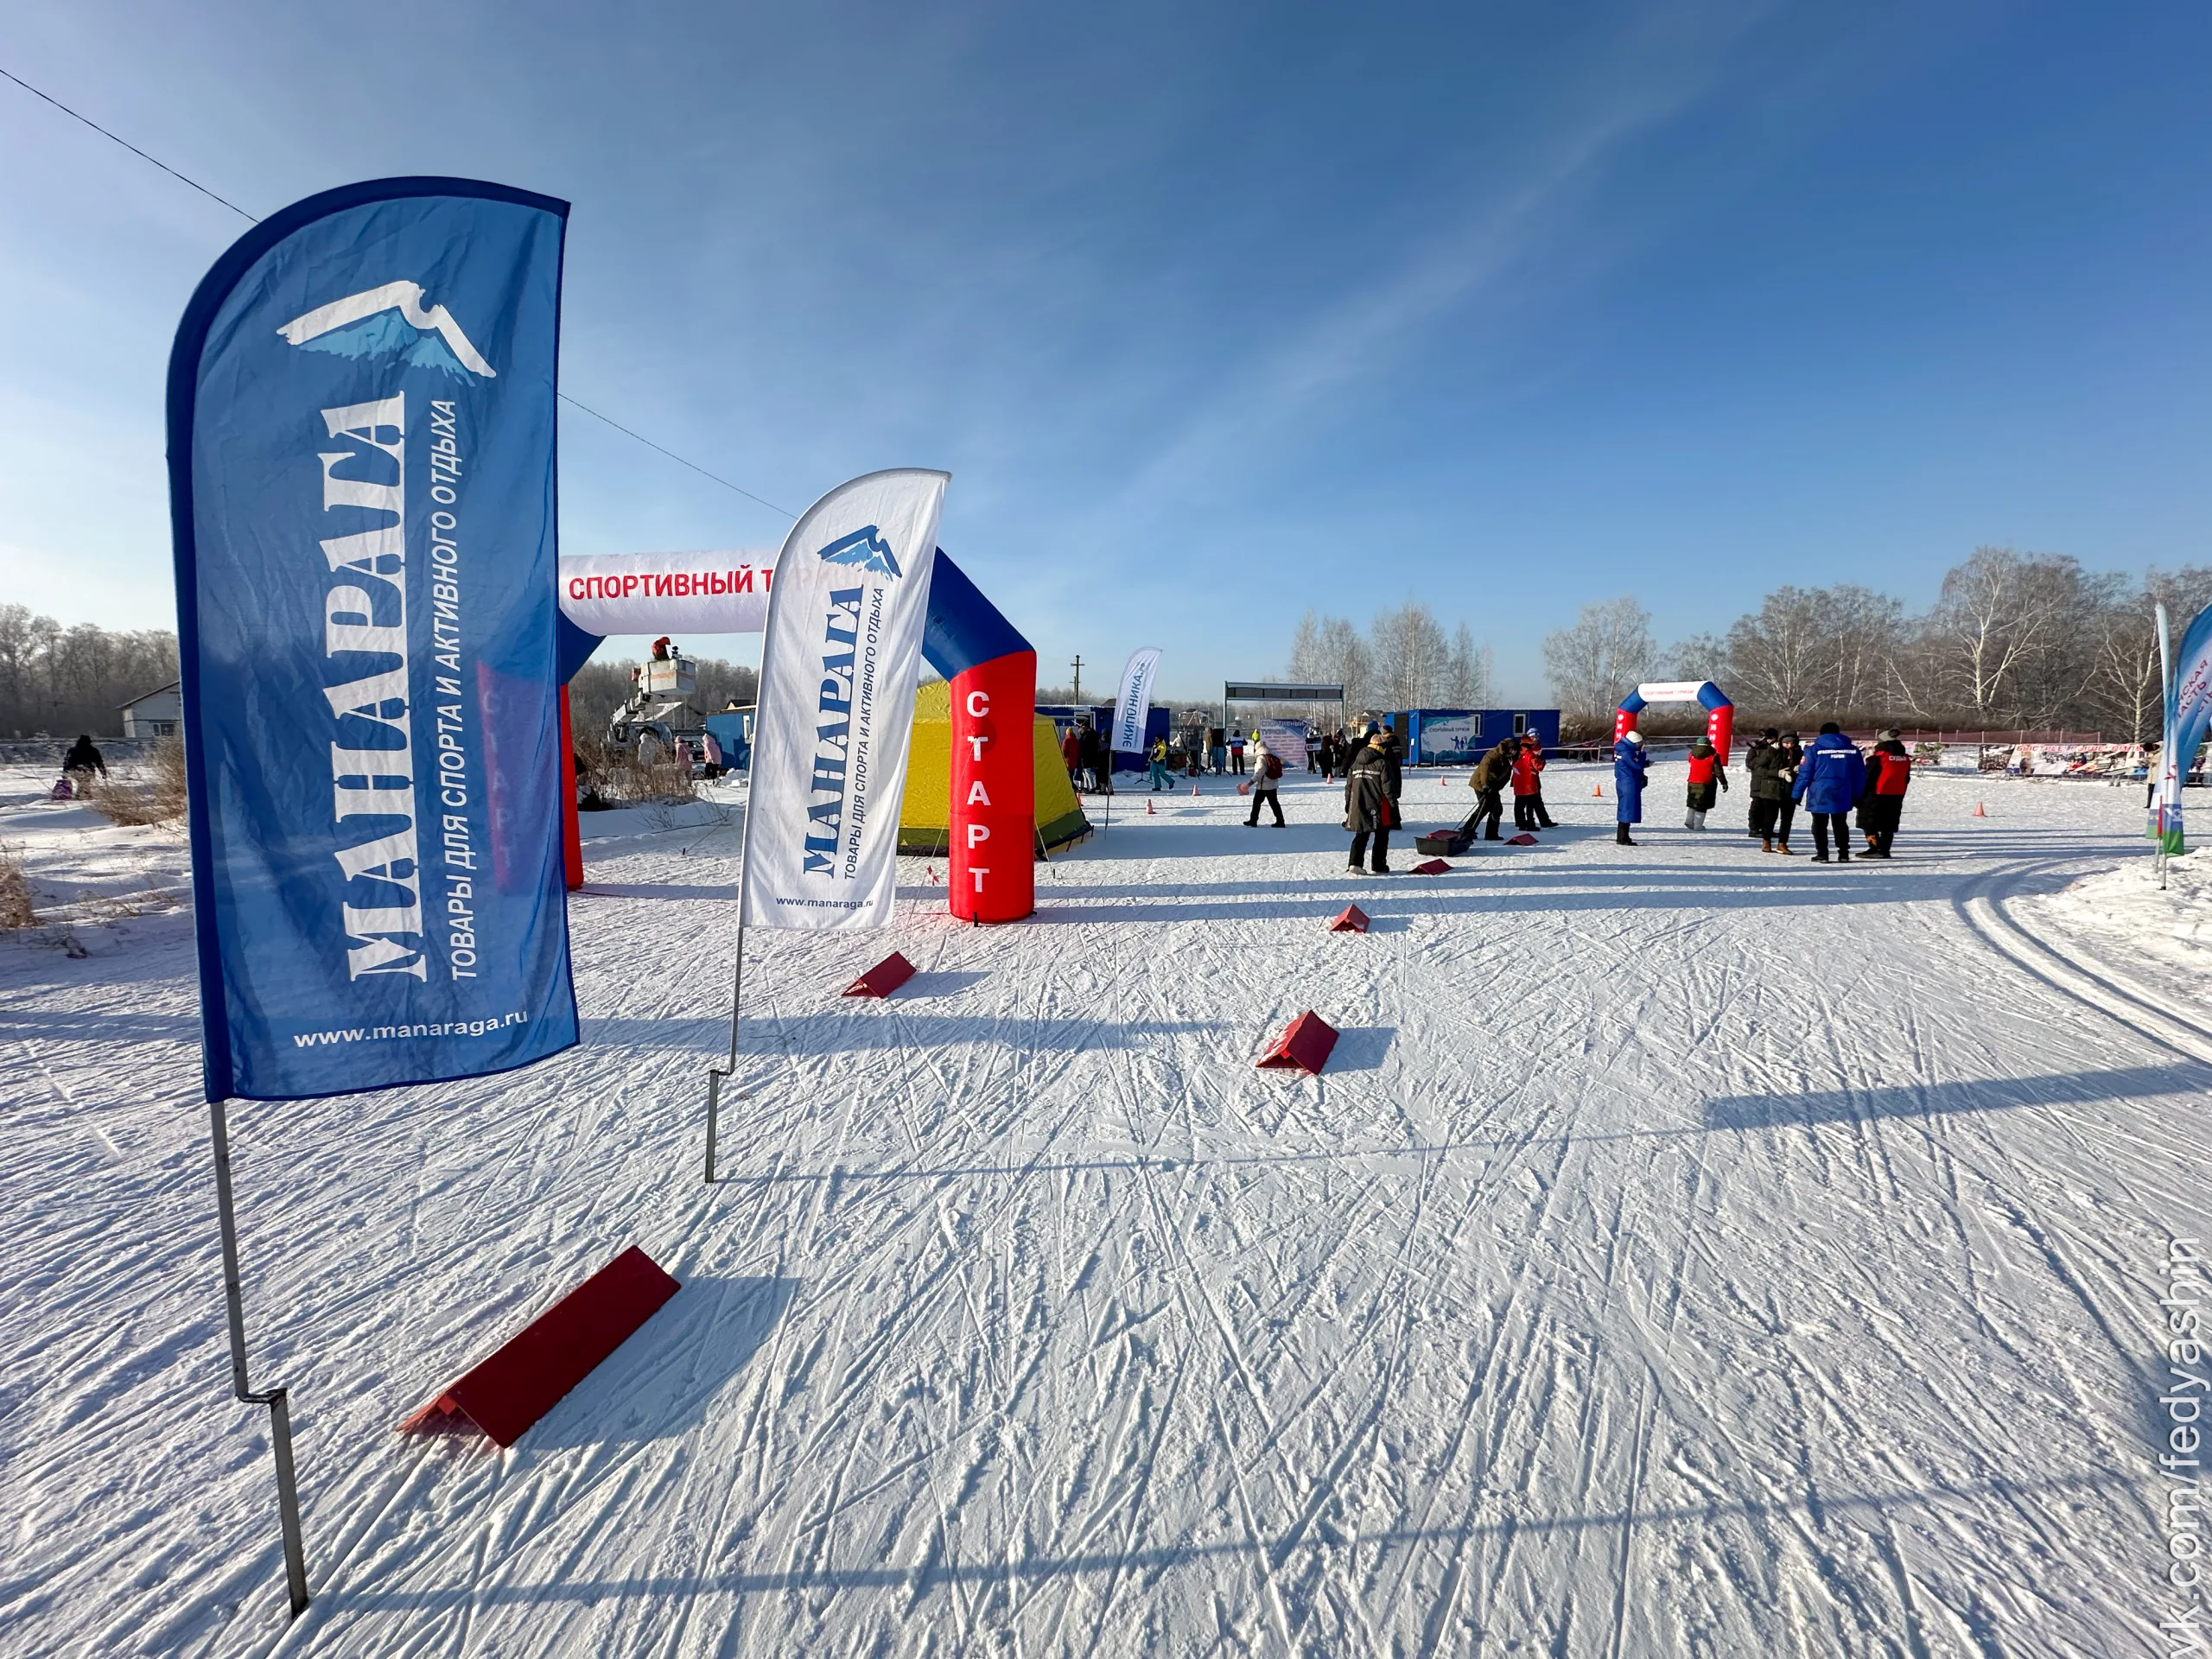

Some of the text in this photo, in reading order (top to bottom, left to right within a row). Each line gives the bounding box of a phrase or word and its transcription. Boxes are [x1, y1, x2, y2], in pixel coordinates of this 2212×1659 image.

[318, 391, 427, 982] МАНАРАГА
[431, 400, 477, 980] ТОВАРЫ ДЛЯ СПОРТА И АКТИВНОГО ОТДЫХА
[569, 564, 753, 600] СПОРТИВНЫЙ
[803, 584, 864, 879] МАНАРАГА
[845, 588, 884, 880] ТОВАРЫ ДЛЯ СПОРТА И АКТИВНОГО ОТДЫХА
[966, 691, 990, 893] СТАРТ
[776, 898, 873, 910] www.manaraga.ru
[294, 1010, 529, 1047] www.manaraga.ru
